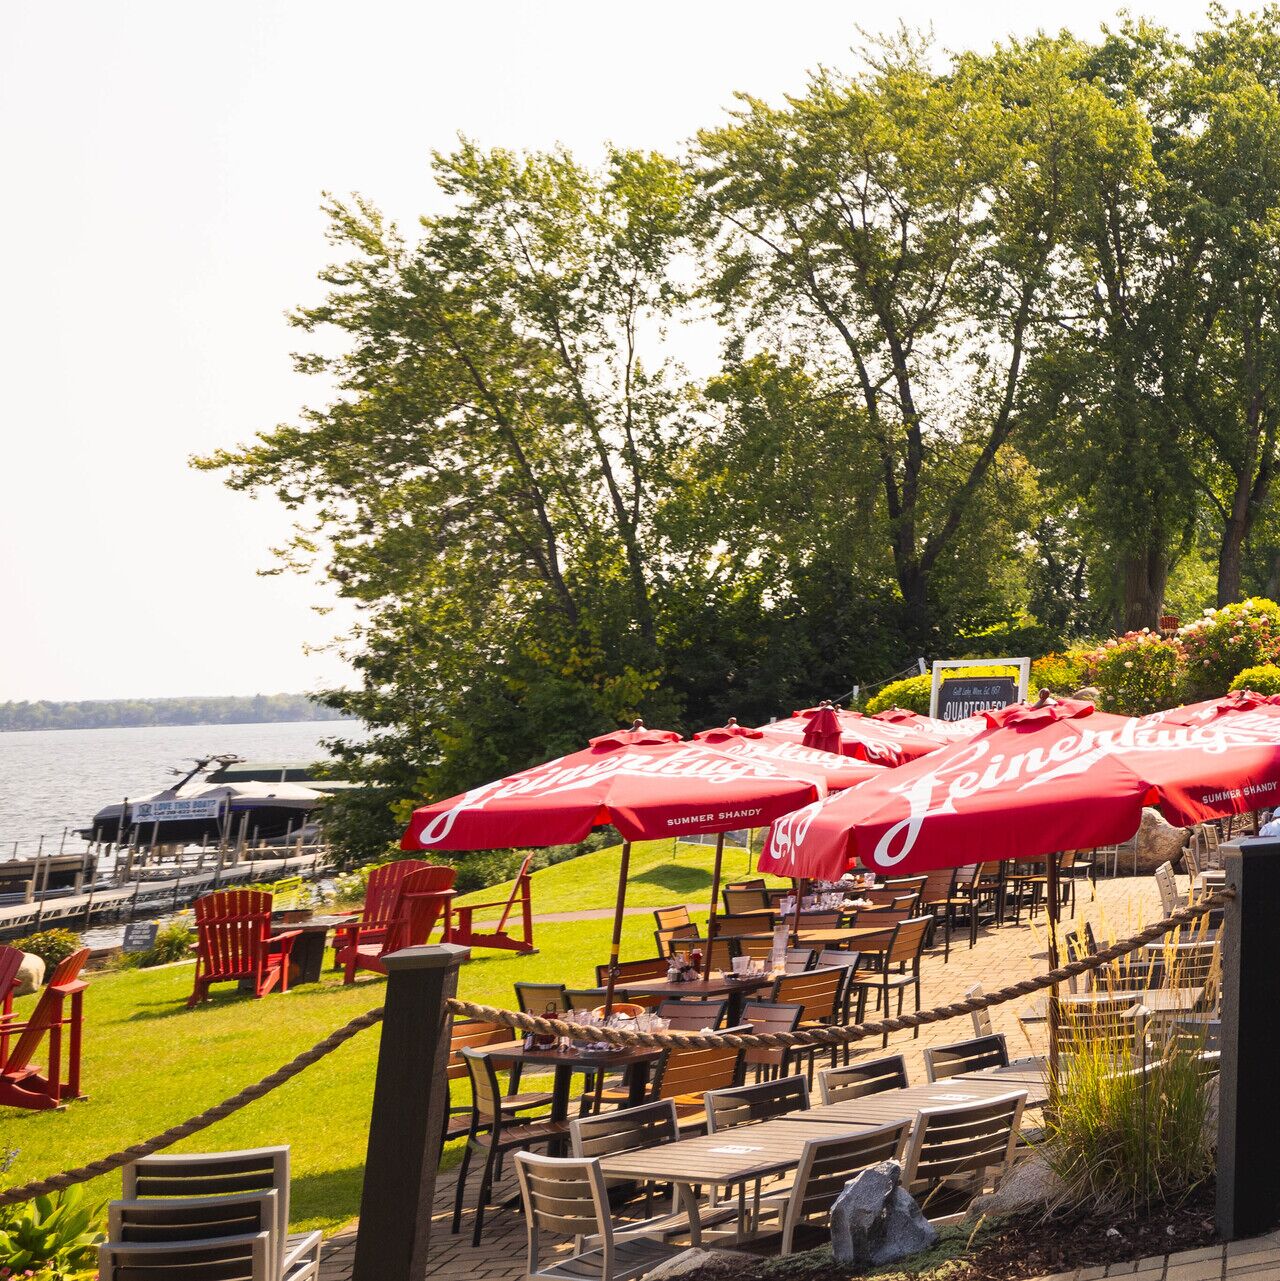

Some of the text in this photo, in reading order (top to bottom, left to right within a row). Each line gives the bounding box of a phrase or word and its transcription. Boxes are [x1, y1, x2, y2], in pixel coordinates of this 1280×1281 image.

[1202, 781, 1278, 804] SUMMER SHANDY
[667, 808, 762, 826] SUMMER SHANDY
